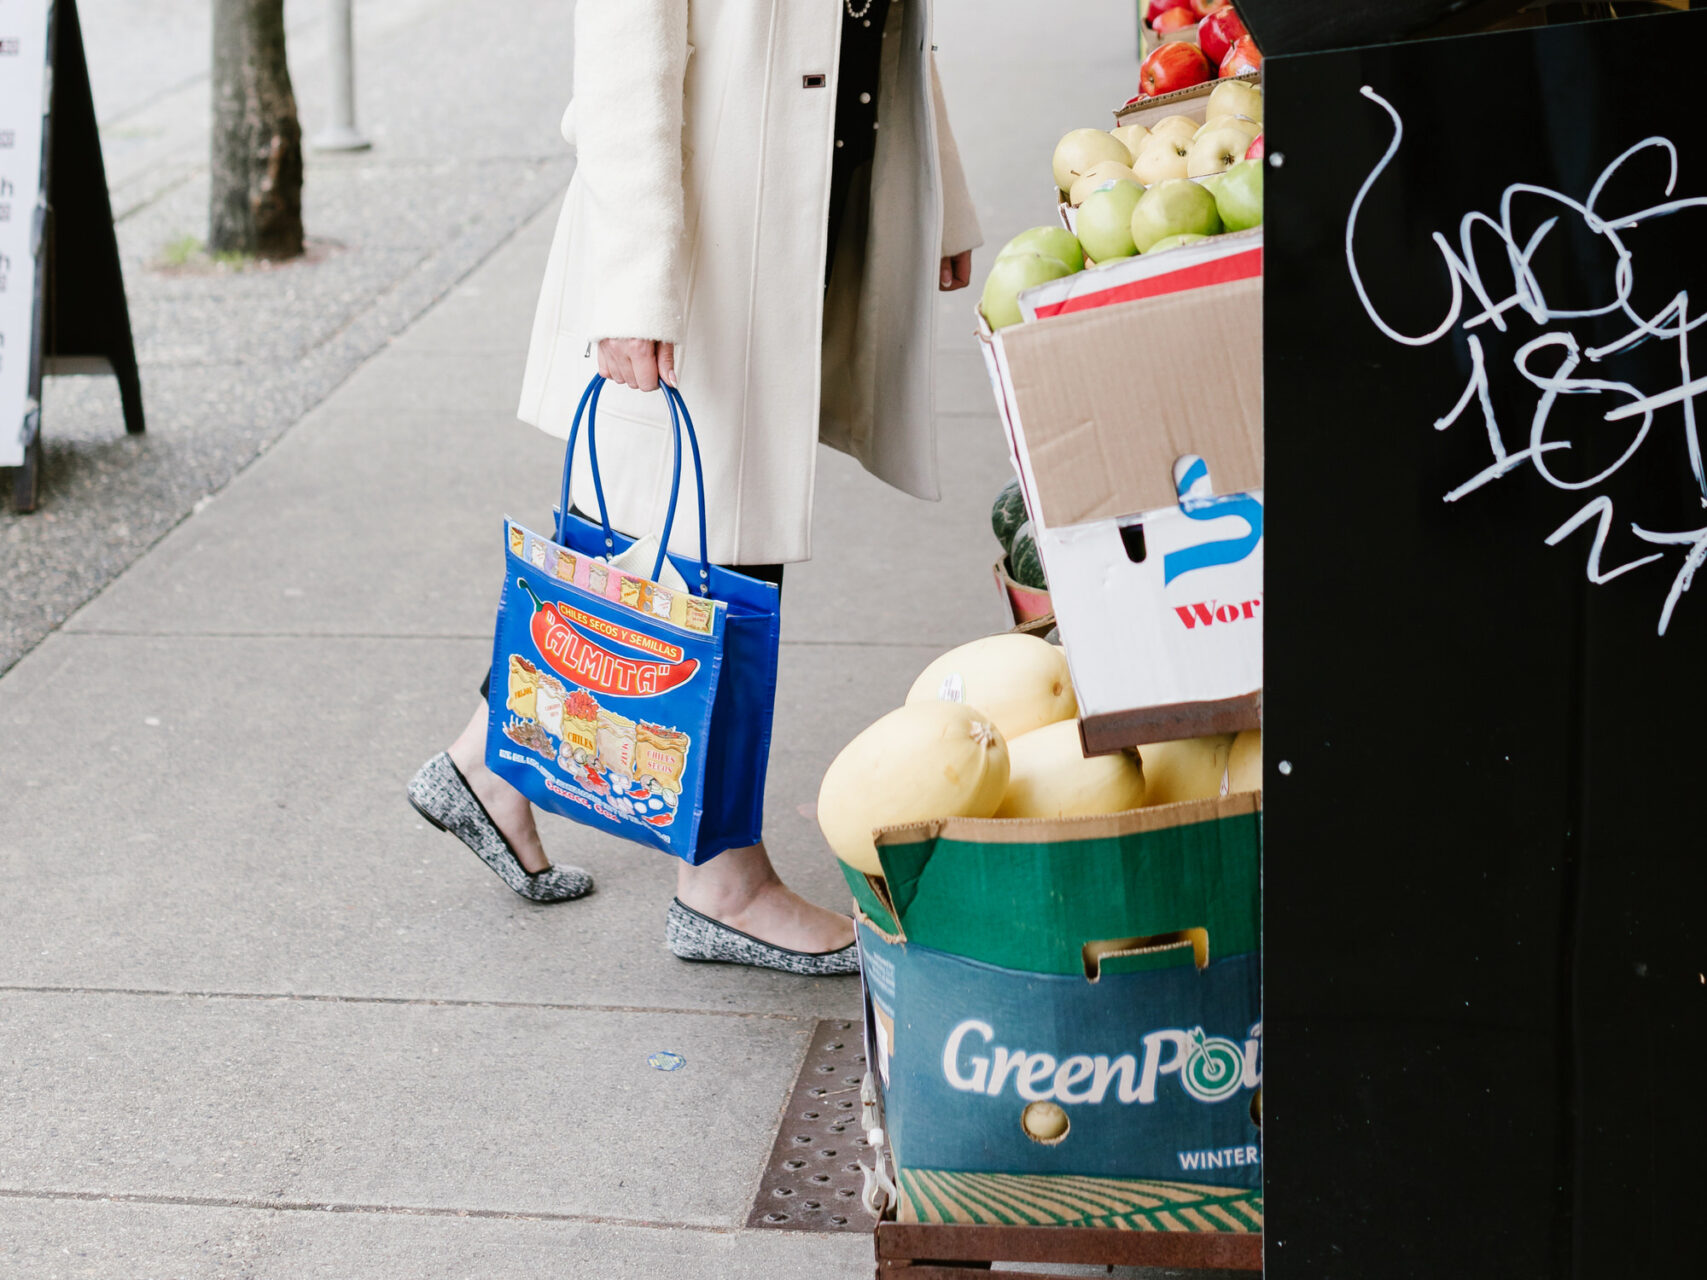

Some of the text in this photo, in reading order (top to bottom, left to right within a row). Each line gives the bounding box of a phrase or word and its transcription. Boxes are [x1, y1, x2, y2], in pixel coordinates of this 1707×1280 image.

[1172, 593, 1263, 629] Wor
[560, 605, 677, 658] CHILES SECOS Y SEMILLAS
[567, 732, 593, 750] CHILES
[646, 750, 675, 764] CHILES
[648, 761, 673, 773] SECOS
[1179, 1146, 1258, 1170] WINTER
